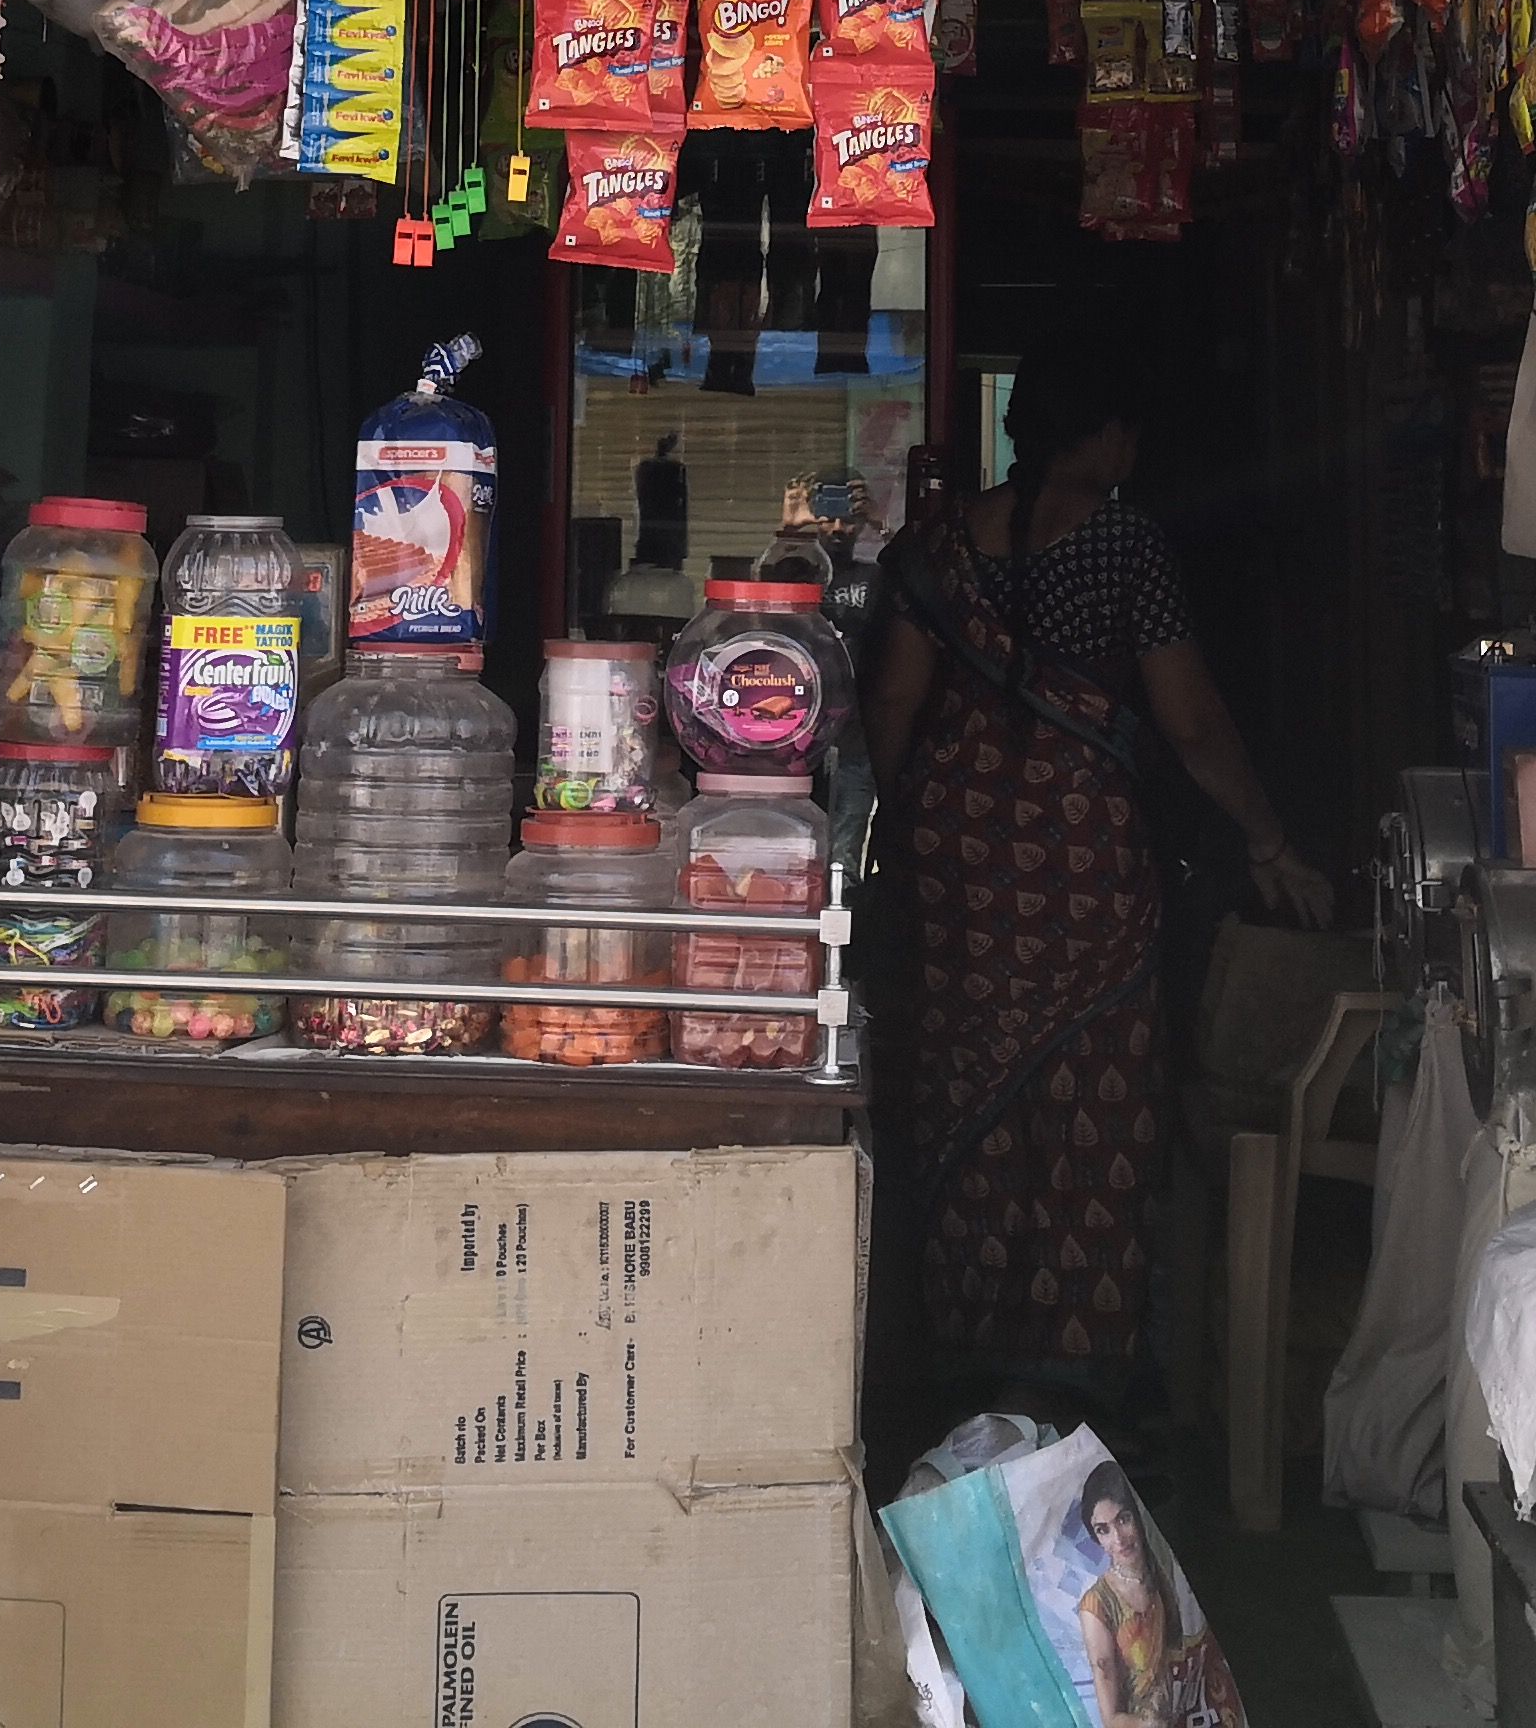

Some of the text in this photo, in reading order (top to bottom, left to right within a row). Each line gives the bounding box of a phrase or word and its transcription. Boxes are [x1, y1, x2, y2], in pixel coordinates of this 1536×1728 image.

[553, 29, 635, 68] TANGLES
[833, 125, 915, 165] TANGLES
[583, 171, 664, 207] TANGLES
[390, 585, 463, 621] Milk
[255, 624, 293, 635] MAGIK
[255, 636, 293, 647] TATTOO
[731, 673, 796, 687] Chocolush
[461, 1204, 478, 1271] Imported by
[624, 1200, 636, 1239] BABU
[496, 1223, 507, 1462] Net Contents Pouches
[516, 1204, 529, 1462] Maximum Retail Price 20 Pouches)
[576, 1373, 589, 1460] Manufactured By
[625, 1374, 636, 1434] Customer
[455, 1434, 466, 1464] Batch
[475, 1407, 487, 1463] Packed On
[535, 1420, 546, 1461] Per Box
[625, 1436, 635, 1458] For
[462, 1622, 475, 1660] OIL
[442, 1603, 458, 1727] PALMOLEIN
